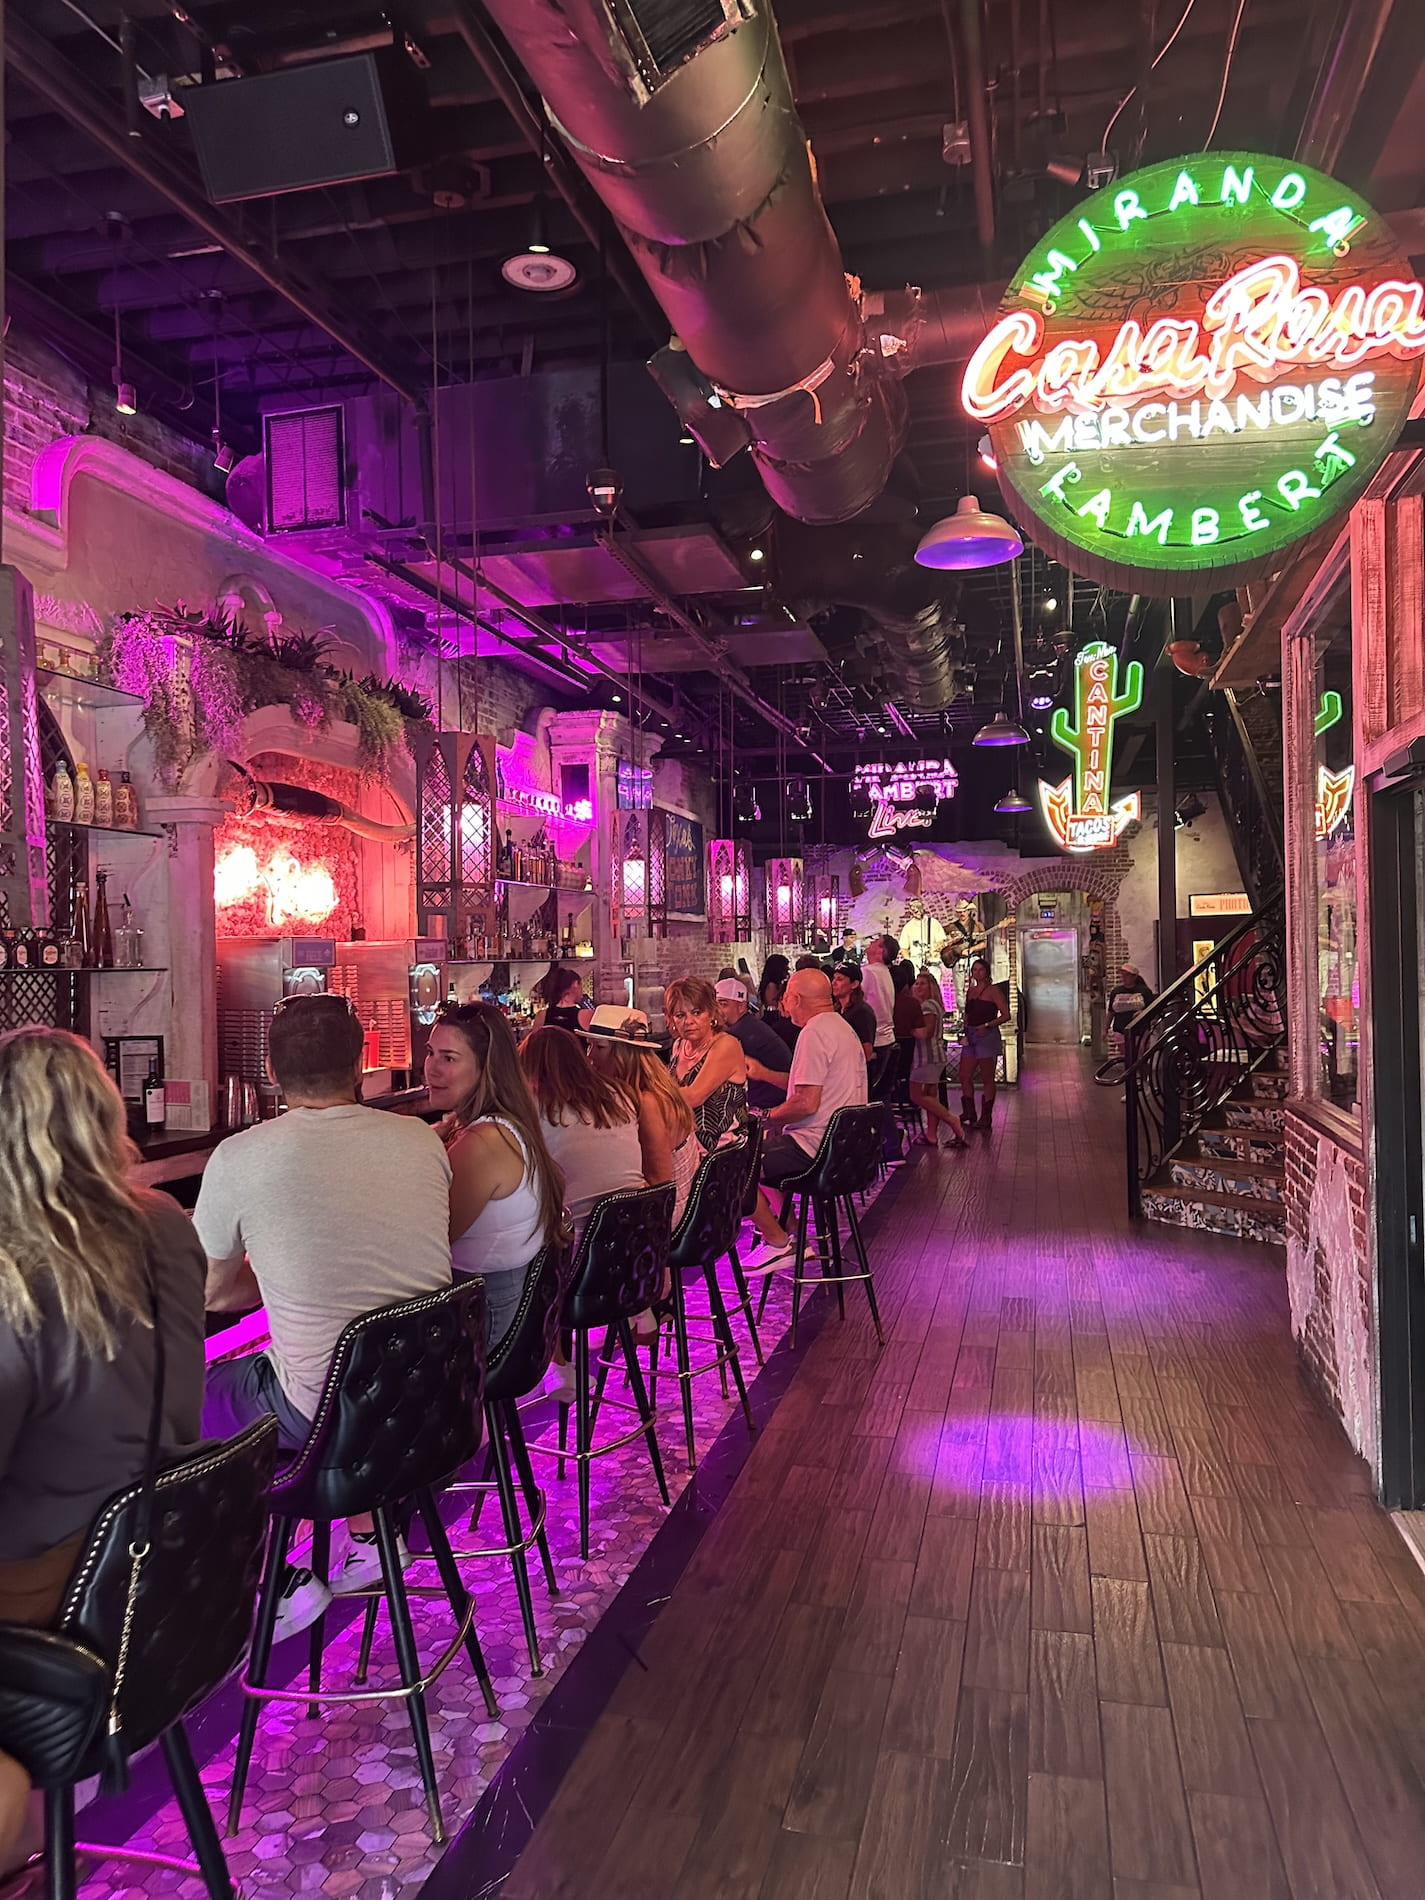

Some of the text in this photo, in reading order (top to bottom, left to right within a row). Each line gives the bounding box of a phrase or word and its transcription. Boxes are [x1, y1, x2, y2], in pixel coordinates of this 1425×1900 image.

[1030, 166, 1364, 297] MIRANDA
[962, 310, 1207, 422] Casa
[1025, 372, 1376, 453] MERCHANDISE
[1040, 432, 1357, 546] LAMBERT
[1081, 660, 1110, 813] CANTINA
[1069, 817, 1111, 838] TACOS
